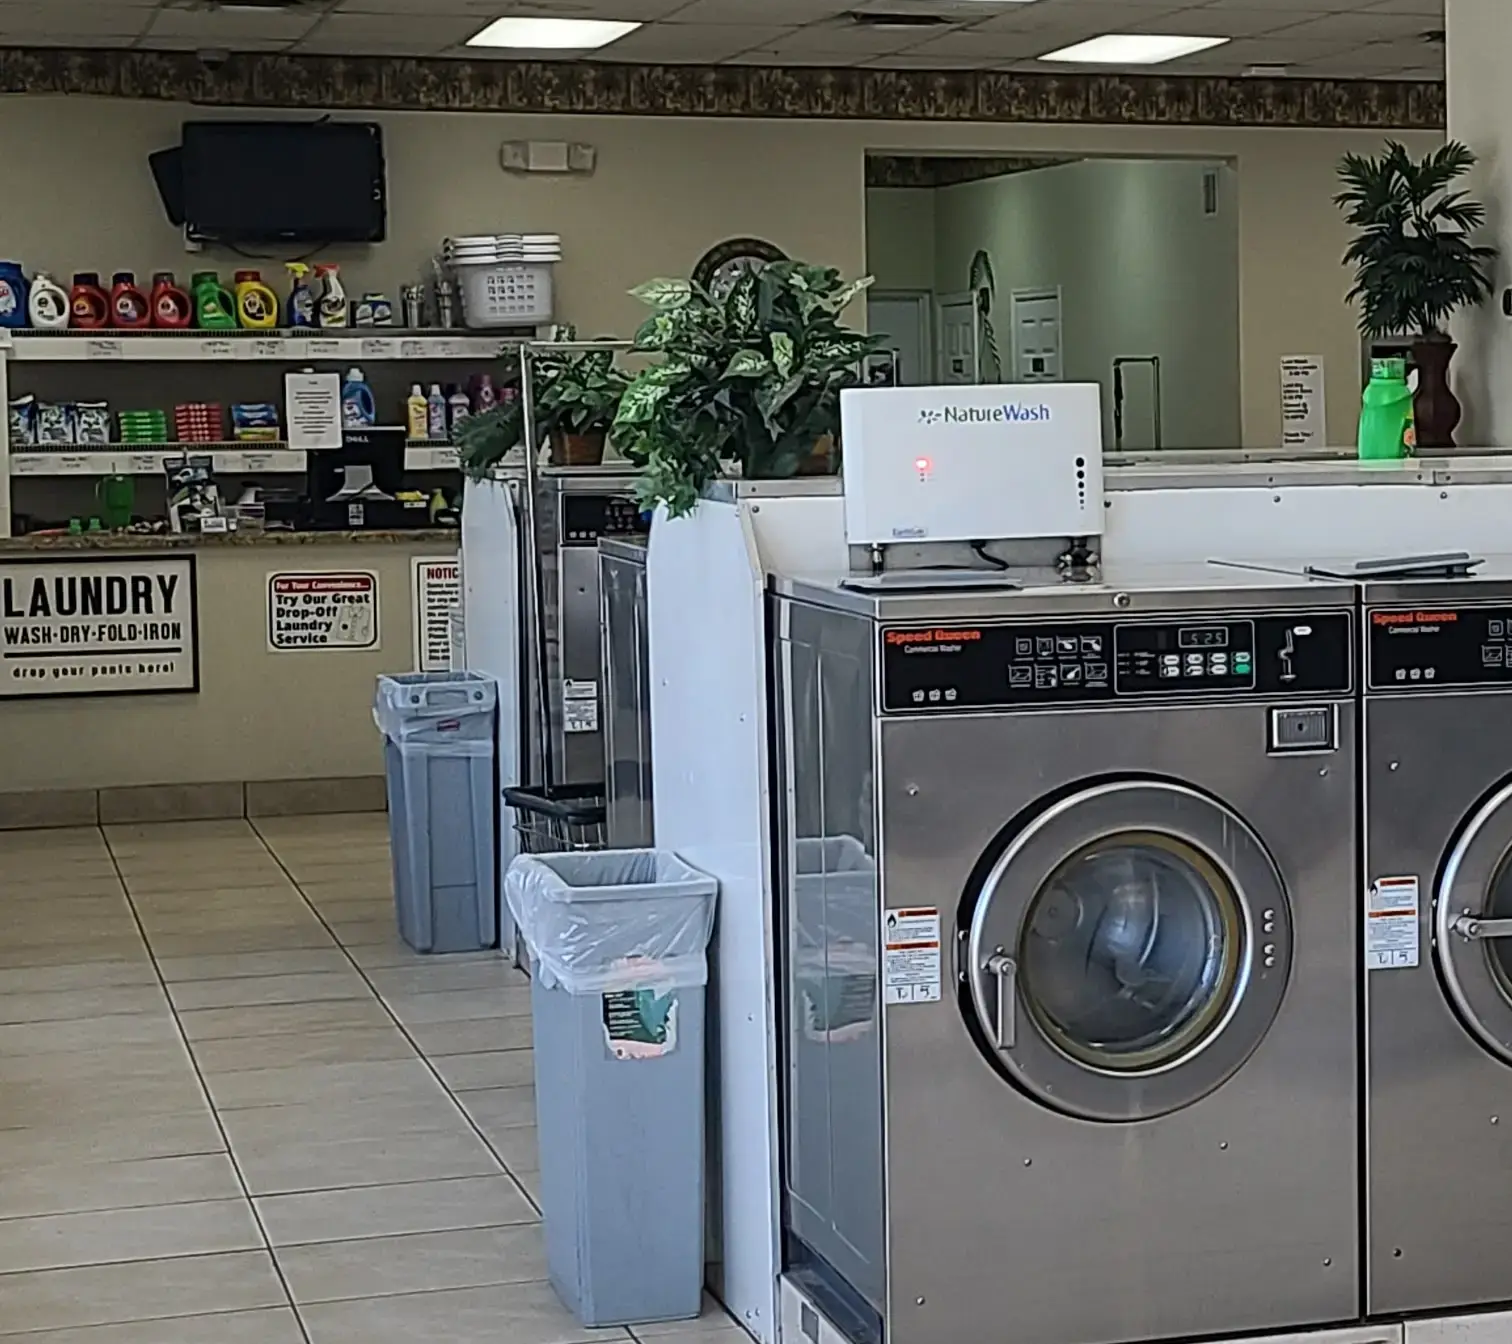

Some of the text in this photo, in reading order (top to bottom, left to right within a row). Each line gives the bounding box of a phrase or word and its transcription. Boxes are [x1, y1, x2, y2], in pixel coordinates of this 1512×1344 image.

[944, 402, 1051, 423] NatureWash
[427, 567, 459, 579] NOTIC
[3, 575, 179, 617] LAUNDRY
[276, 593, 370, 607] Try Our Great
[276, 606, 338, 619] Drop-Off
[276, 620, 333, 632] Laundry
[276, 633, 327, 644] Service
[887, 631, 932, 645] Speed
[13, 667, 46, 678] drop
[52, 666, 85, 678] your
[91, 664, 132, 677] pants
